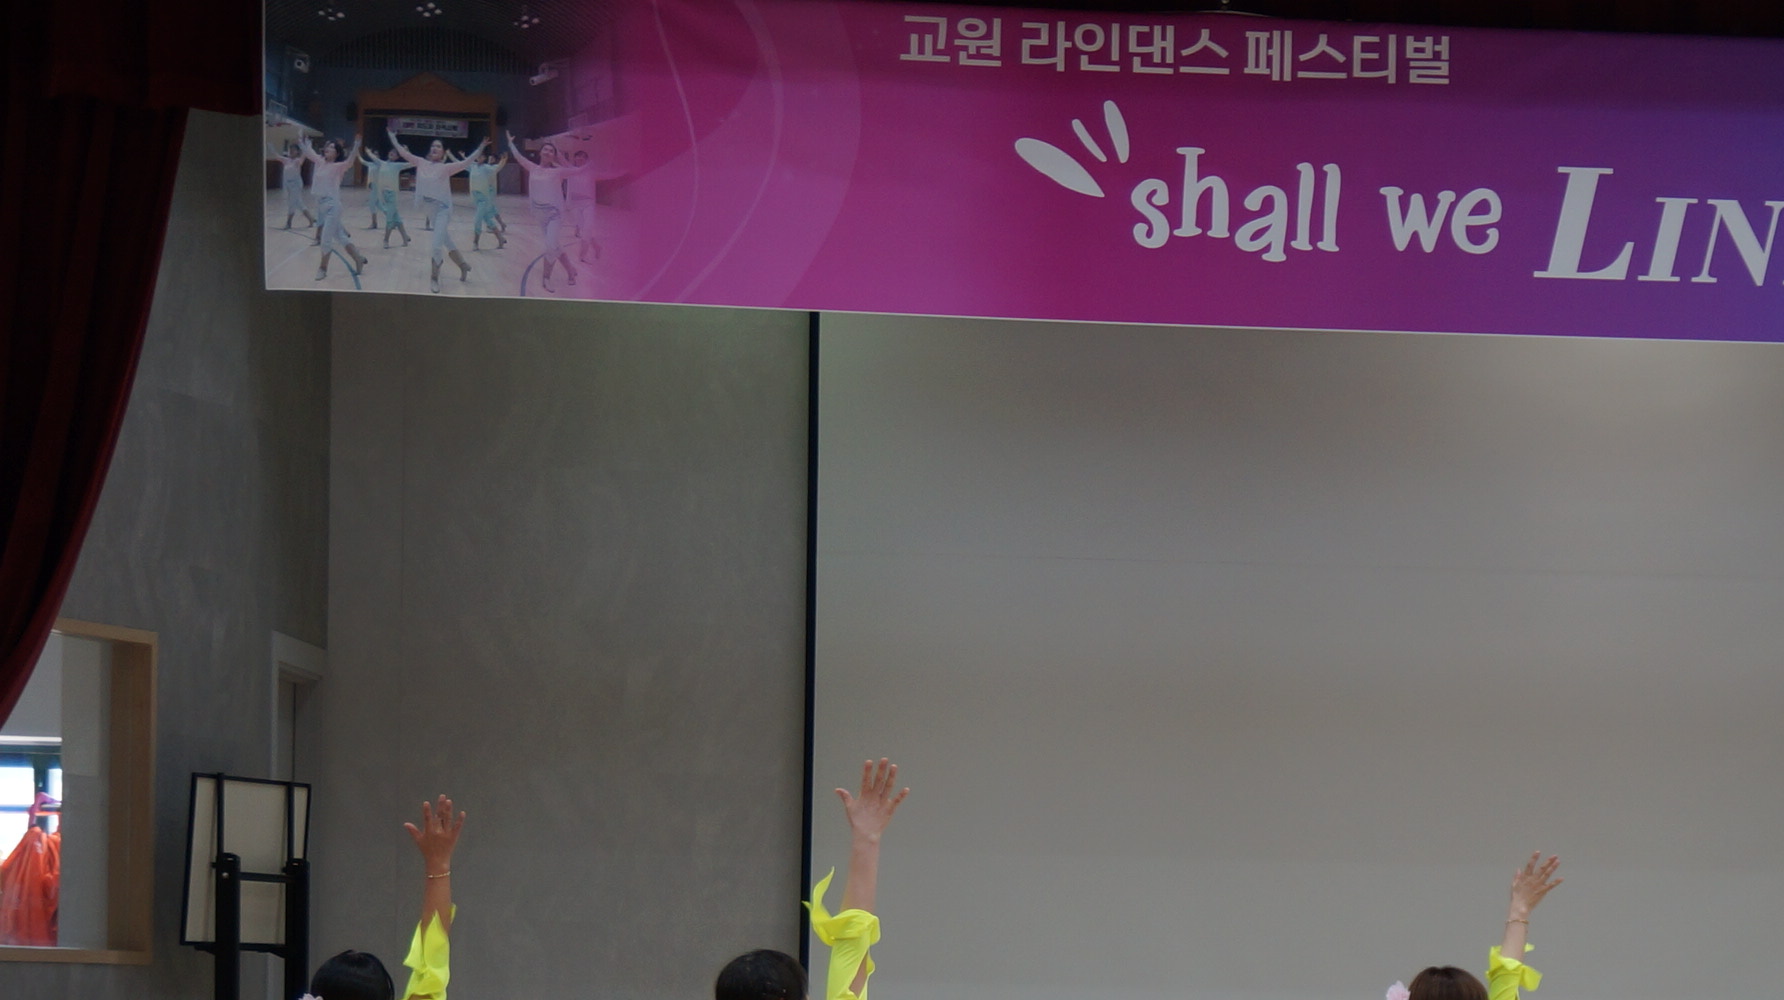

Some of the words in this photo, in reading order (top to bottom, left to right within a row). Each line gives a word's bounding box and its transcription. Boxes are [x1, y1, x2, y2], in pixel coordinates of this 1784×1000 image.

[899, 16, 1002, 67] 교원
[1020, 22, 1230, 75] 라인댄스
[1243, 30, 1451, 84] 페스티벌
[1130, 146, 1342, 262] shall
[1380, 186, 1503, 254] we
